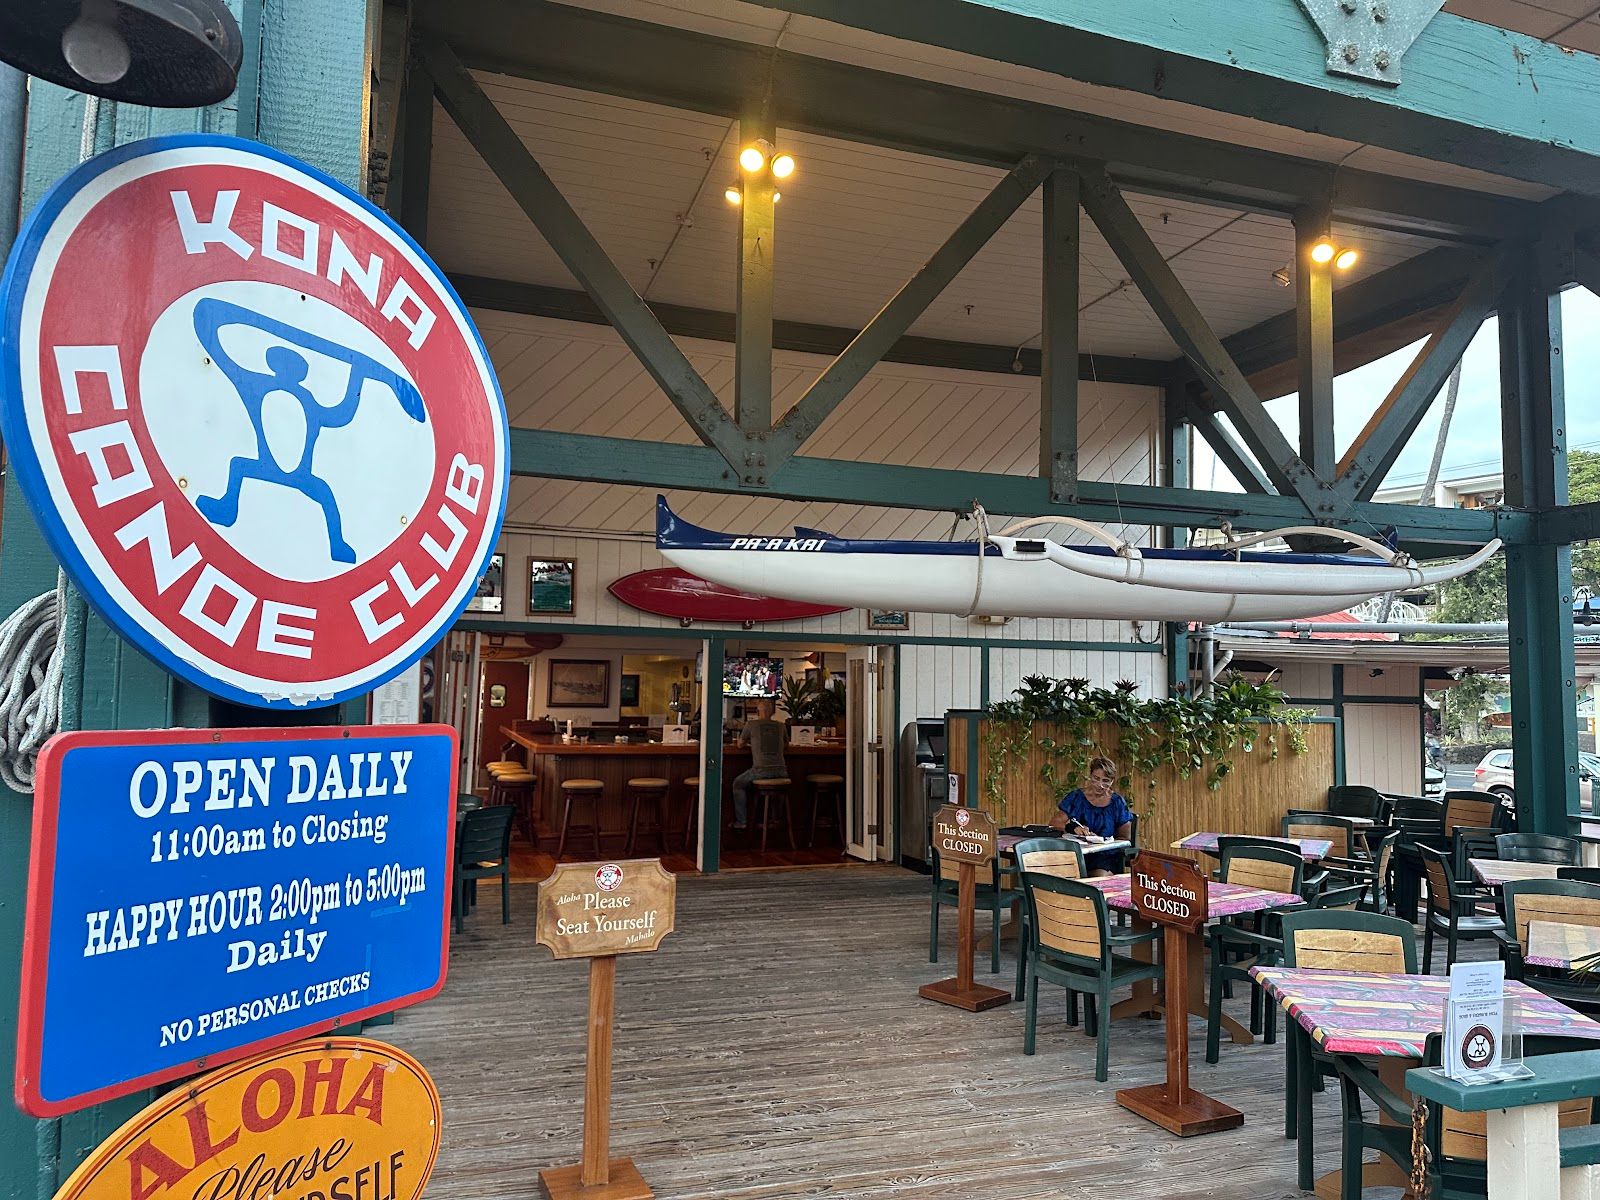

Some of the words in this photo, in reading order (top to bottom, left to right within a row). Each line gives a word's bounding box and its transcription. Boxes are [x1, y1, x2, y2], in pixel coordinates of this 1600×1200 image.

[170, 189, 438, 350] KONA
[53, 344, 318, 659] CANOE
[350, 452, 485, 645] CLUB
[784, 538, 827, 551] KAI
[129, 757, 276, 819] OPEN
[286, 750, 413, 804] DAILY
[150, 823, 266, 863] 11:00am
[272, 820, 296, 848] to
[302, 809, 389, 844] Closing
[938, 822, 957, 836] This
[957, 825, 989, 842] Section
[942, 838, 983, 855] CLOSED
[84, 898, 184, 957] HAPPY
[187, 885, 263, 937] HOUR
[269, 877, 341, 924] 2:00pm
[344, 873, 363, 906] to
[366, 862, 426, 906] 5:00pm
[556, 892, 581, 906] Aloha
[583, 892, 631, 911] Please
[1137, 872, 1159, 892] This
[1160, 878, 1197, 902] Section
[1143, 893, 1190, 918] CLOSED
[556, 918, 590, 936] Seat
[593, 910, 658, 933] Yourself
[625, 929, 655, 946] Mahalo
[226, 928, 328, 973] Daily
[159, 1019, 194, 1048] NO
[197, 990, 301, 1037] PERSONAL
[304, 971, 371, 1006] CHECKS
[124, 1057, 388, 1200] ALOHA
[192, 1138, 354, 1200] Please
